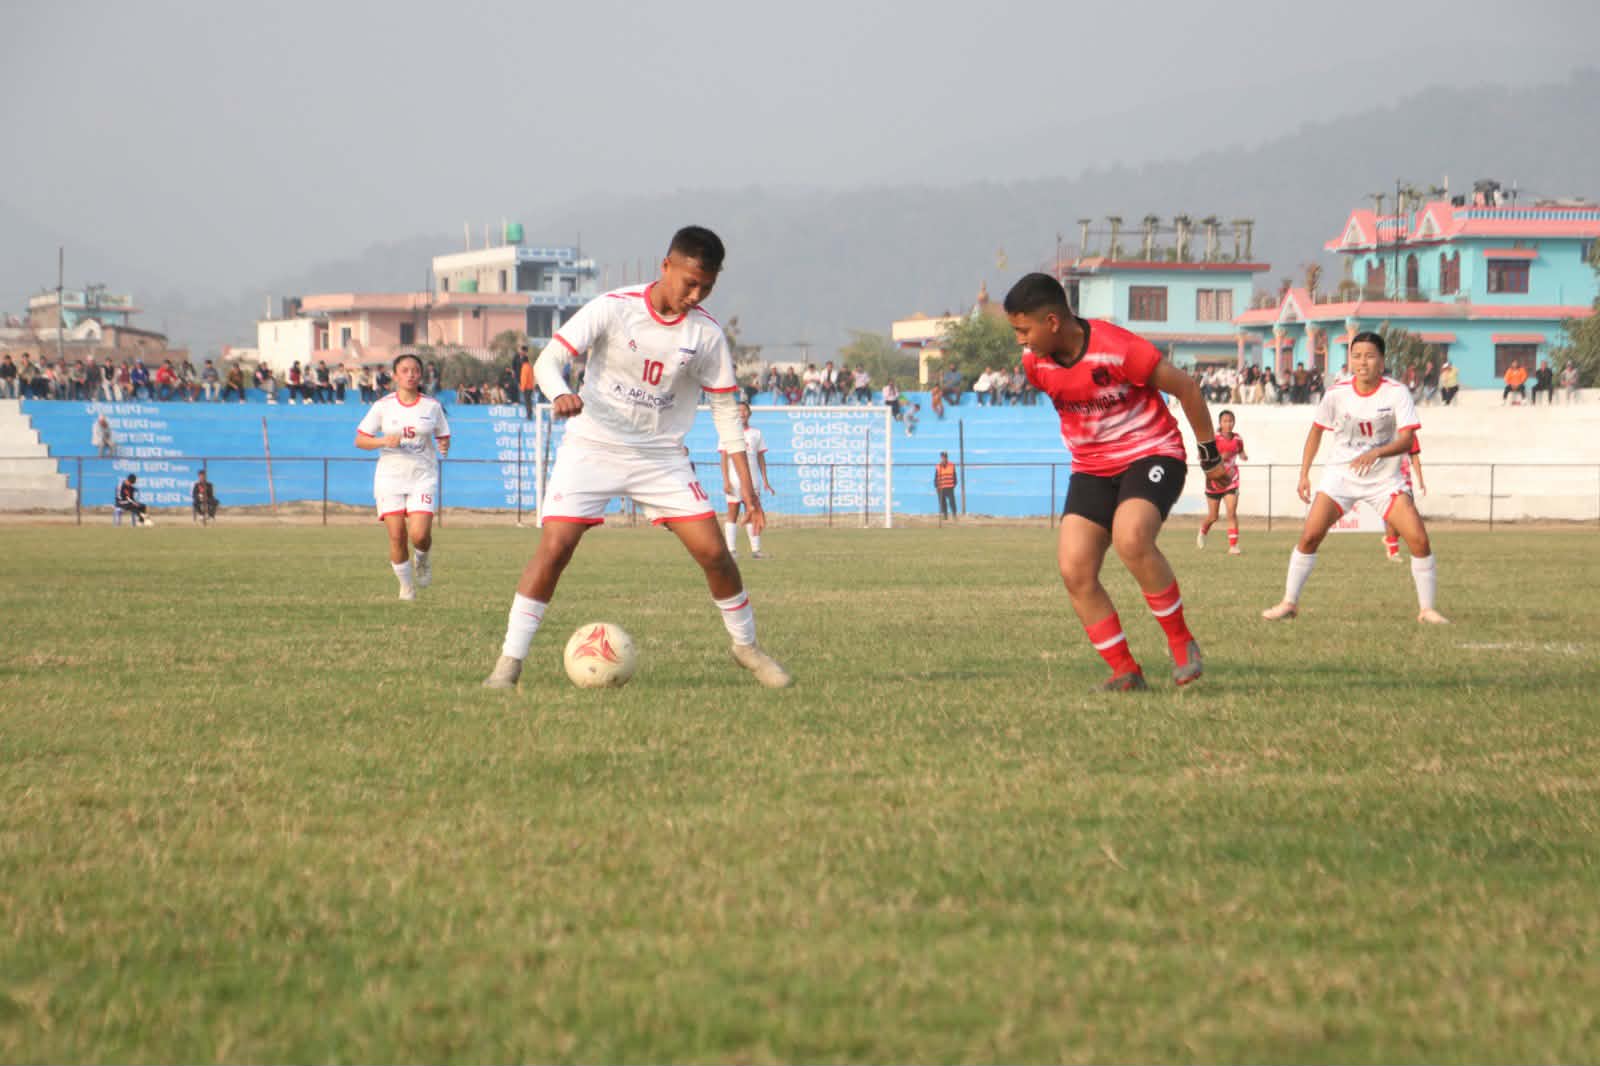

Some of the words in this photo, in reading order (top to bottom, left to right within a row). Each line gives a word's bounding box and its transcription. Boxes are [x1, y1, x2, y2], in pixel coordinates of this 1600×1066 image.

[642, 359, 664, 386] 10
[403, 426, 416, 439] 15
[793, 422, 870, 434] GoldStar
[1359, 421, 1373, 438] 11
[792, 436, 869, 449] GoldStar
[794, 452, 873, 464] GoldStar
[1148, 465, 1165, 482] 6
